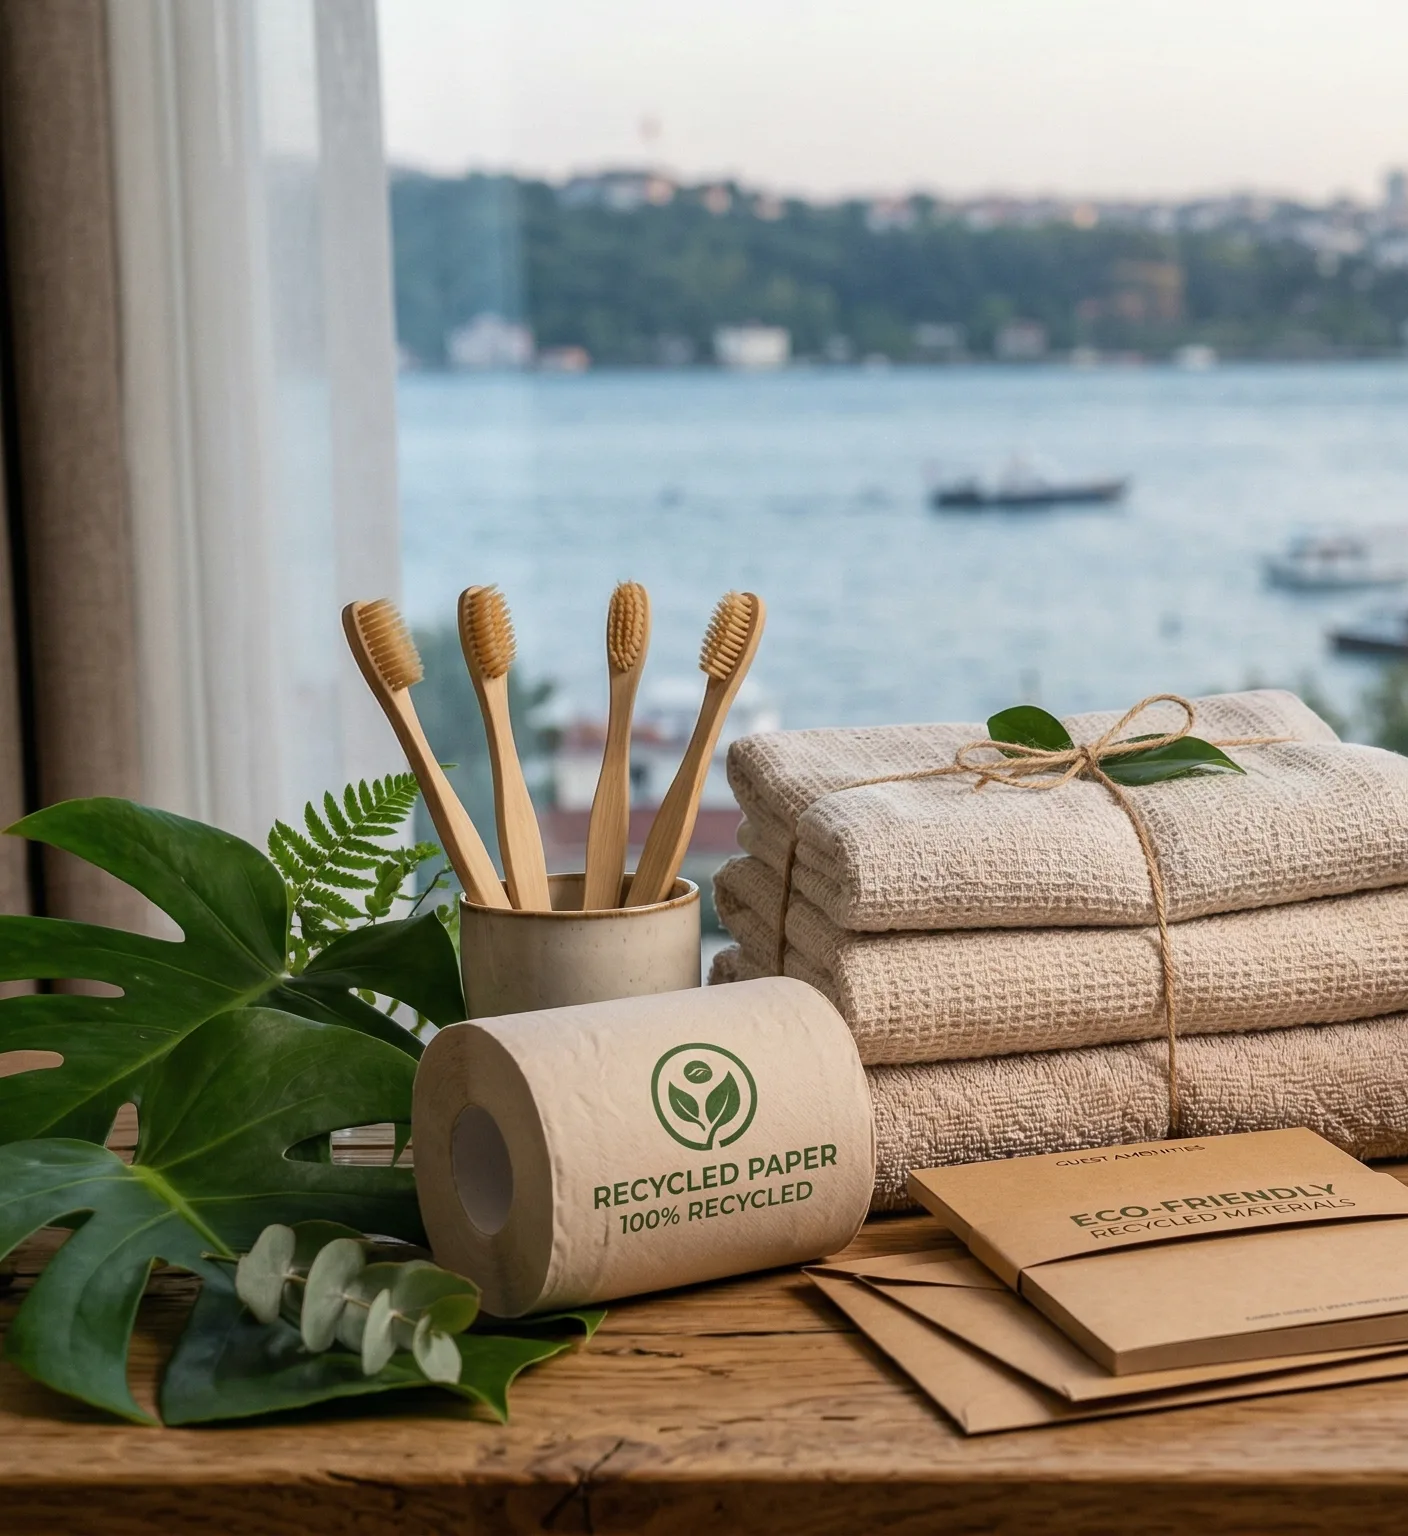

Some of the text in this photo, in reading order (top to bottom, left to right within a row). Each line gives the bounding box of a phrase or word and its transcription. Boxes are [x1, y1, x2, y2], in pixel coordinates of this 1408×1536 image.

[594, 1143, 837, 1209] RECYCLED PAPER
[1056, 1156, 1108, 1166] GUEST
[619, 1181, 813, 1234] 100% RECYCLED
[1070, 1184, 1335, 1227] ECO-FRIENDLY
[1090, 1199, 1356, 1239] RECYCLED MATERIALS
